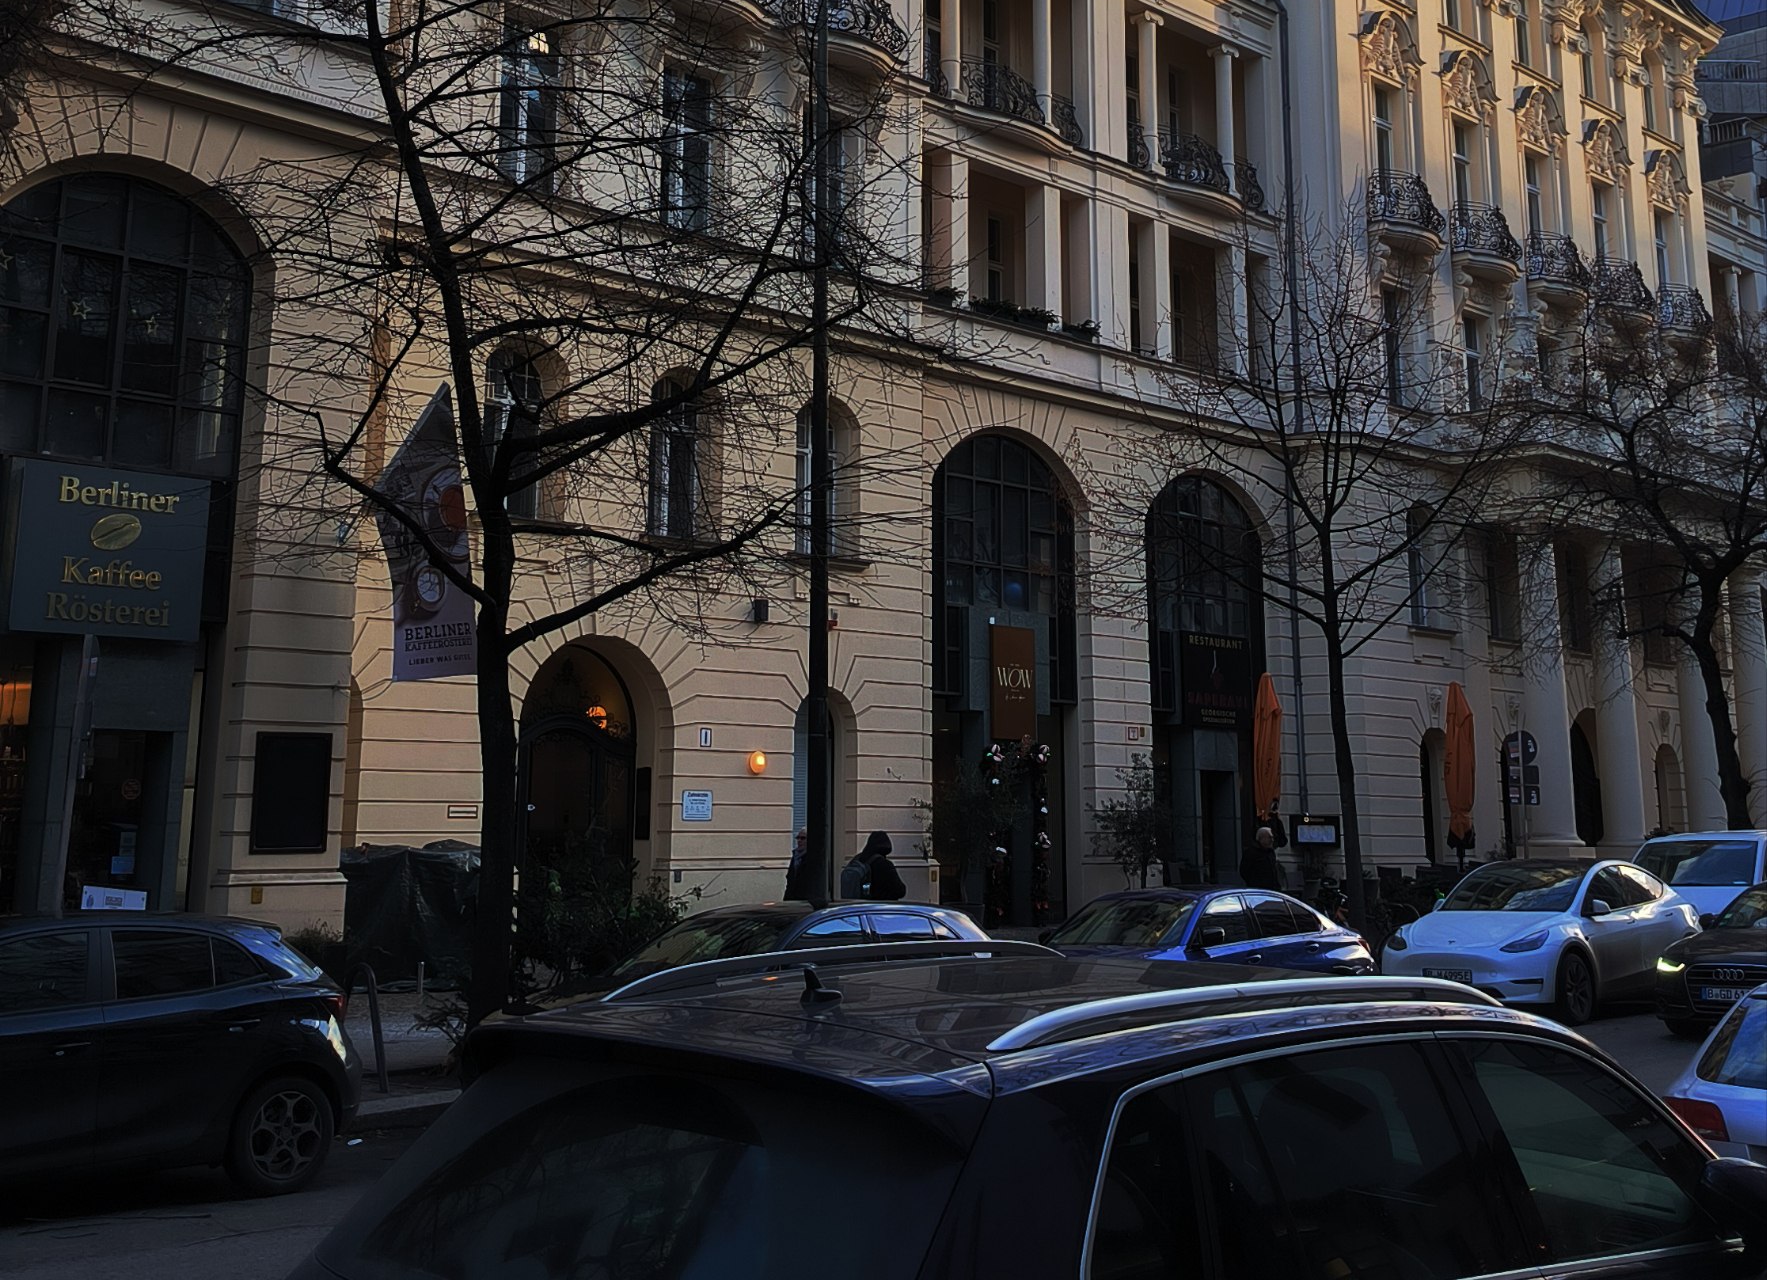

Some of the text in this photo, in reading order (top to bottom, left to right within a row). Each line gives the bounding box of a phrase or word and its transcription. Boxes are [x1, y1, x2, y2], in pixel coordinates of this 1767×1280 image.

[59, 475, 180, 514] Berliner
[61, 555, 163, 591] Kaffee
[45, 592, 170, 627] Rösterei
[405, 623, 472, 640] BERLINER
[1188, 635, 1243, 649] RESTAURANT
[997, 666, 1033, 689] WOW
[1708, 989, 1713, 998] B
